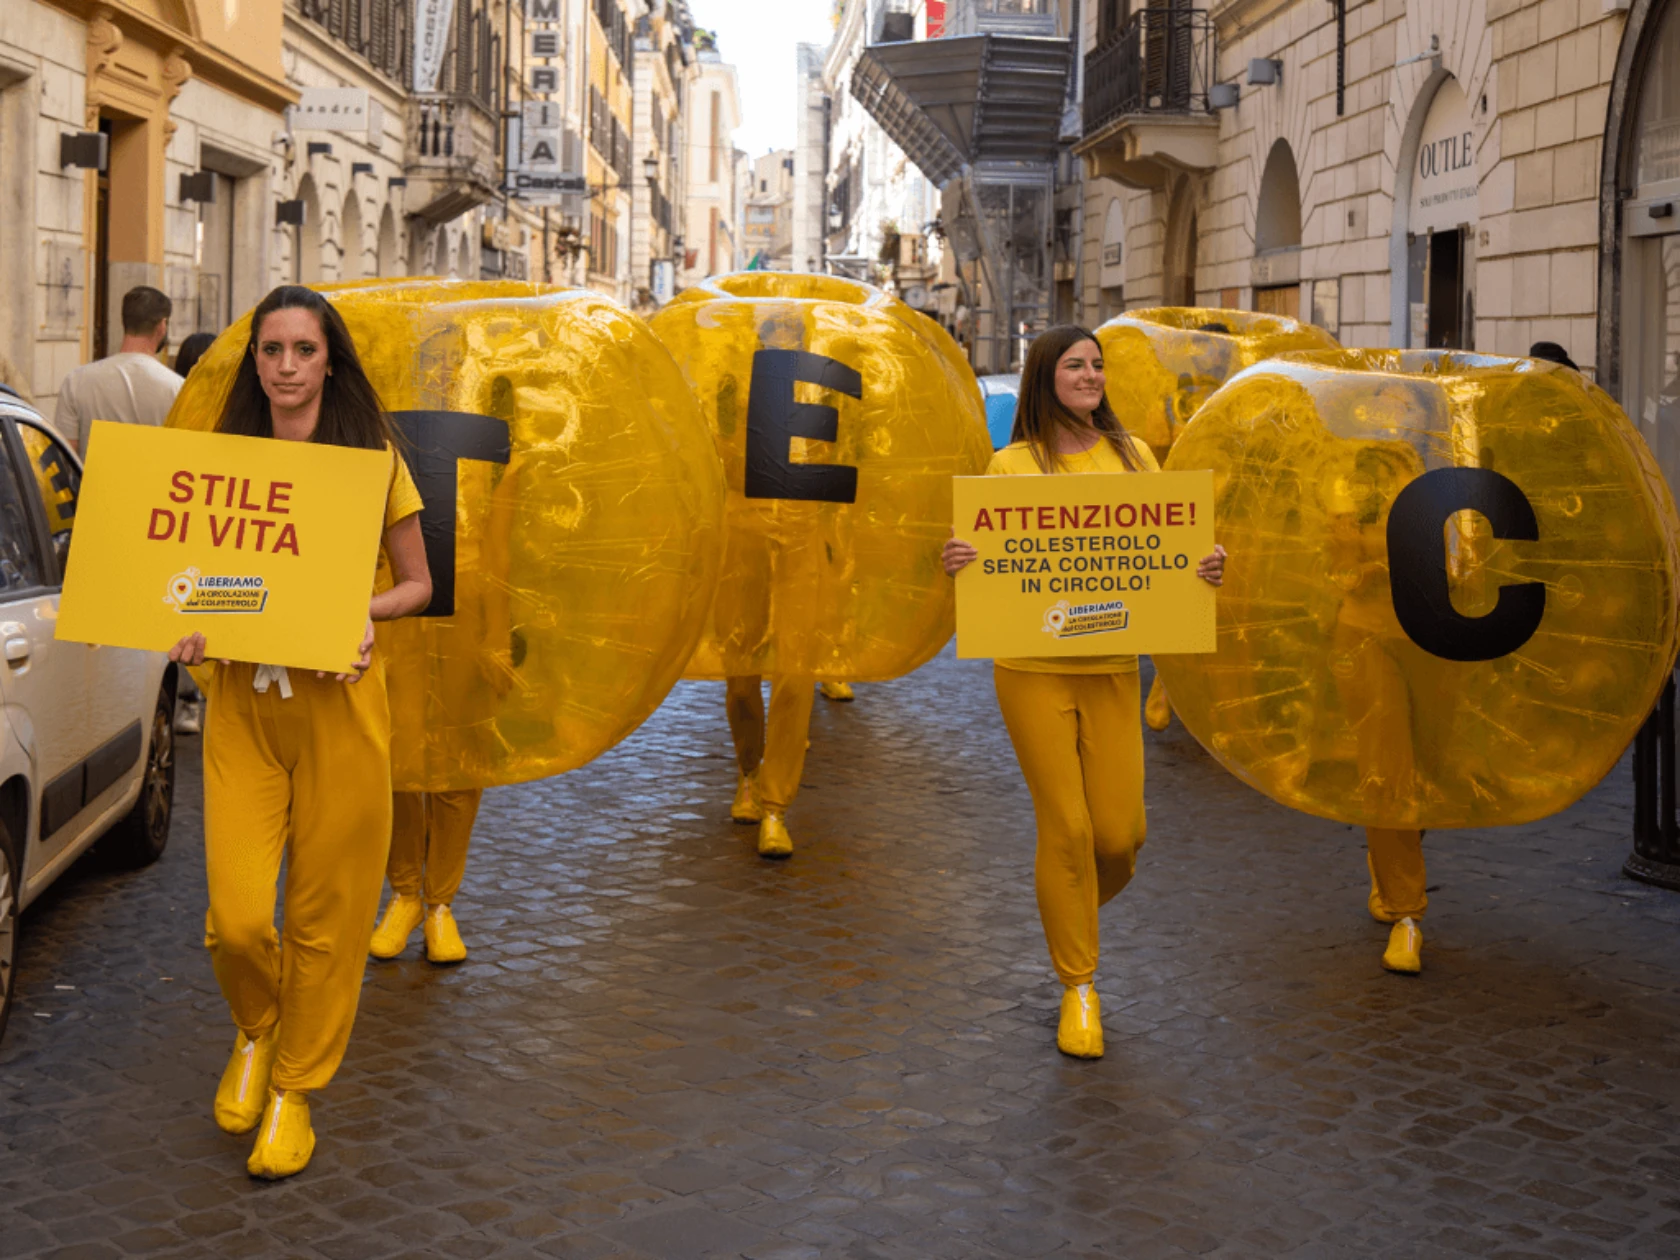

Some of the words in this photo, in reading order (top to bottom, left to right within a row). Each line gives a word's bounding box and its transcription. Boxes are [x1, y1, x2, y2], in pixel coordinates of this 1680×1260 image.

[745, 348, 862, 503] E
[168, 470, 293, 514] STILE
[973, 502, 1196, 532] ATTENZIONE!
[147, 508, 190, 543] DI
[209, 514, 300, 556] VITA
[1004, 534, 1161, 554] COLESTEROLO
[983, 558, 1052, 575] SENZA
[1059, 554, 1189, 573] CONTROLLO
[1386, 467, 1546, 661] C
[197, 576, 263, 587] LIBERIAMO
[1021, 579, 1041, 593] IN
[1049, 576, 1151, 593] CIRCOLO!
[196, 590, 206, 598] LA
[1069, 601, 1123, 616] LIBERIAMO
